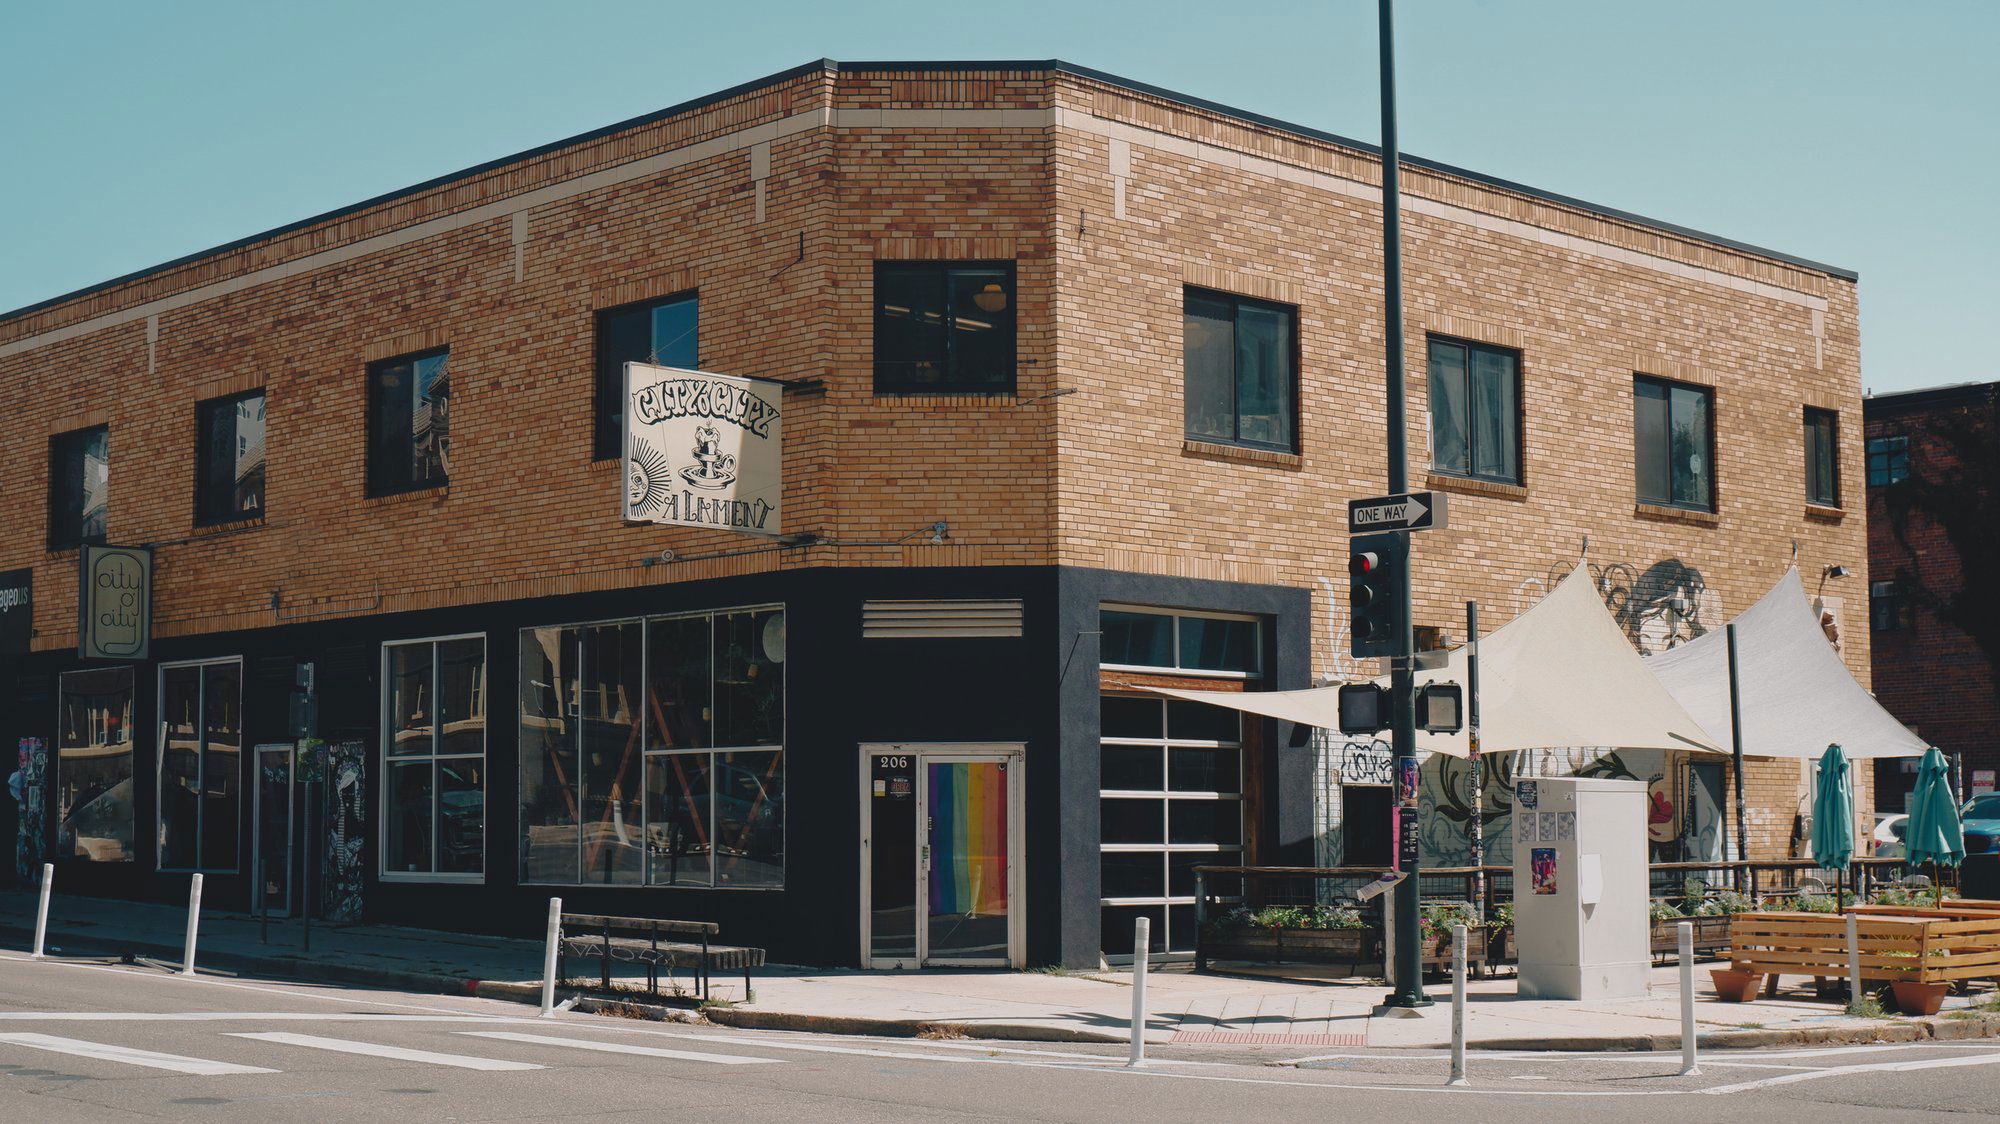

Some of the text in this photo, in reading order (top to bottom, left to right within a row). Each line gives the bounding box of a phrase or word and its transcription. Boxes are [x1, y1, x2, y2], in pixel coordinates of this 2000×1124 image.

[632, 378, 708, 426] CITY
[707, 380, 780, 440] CITY
[662, 489, 775, 530] A LAMENT
[1357, 504, 1407, 523] ONE WAY
[98, 560, 141, 614] city
[101, 605, 137, 638] city
[880, 756, 908, 769] 206
